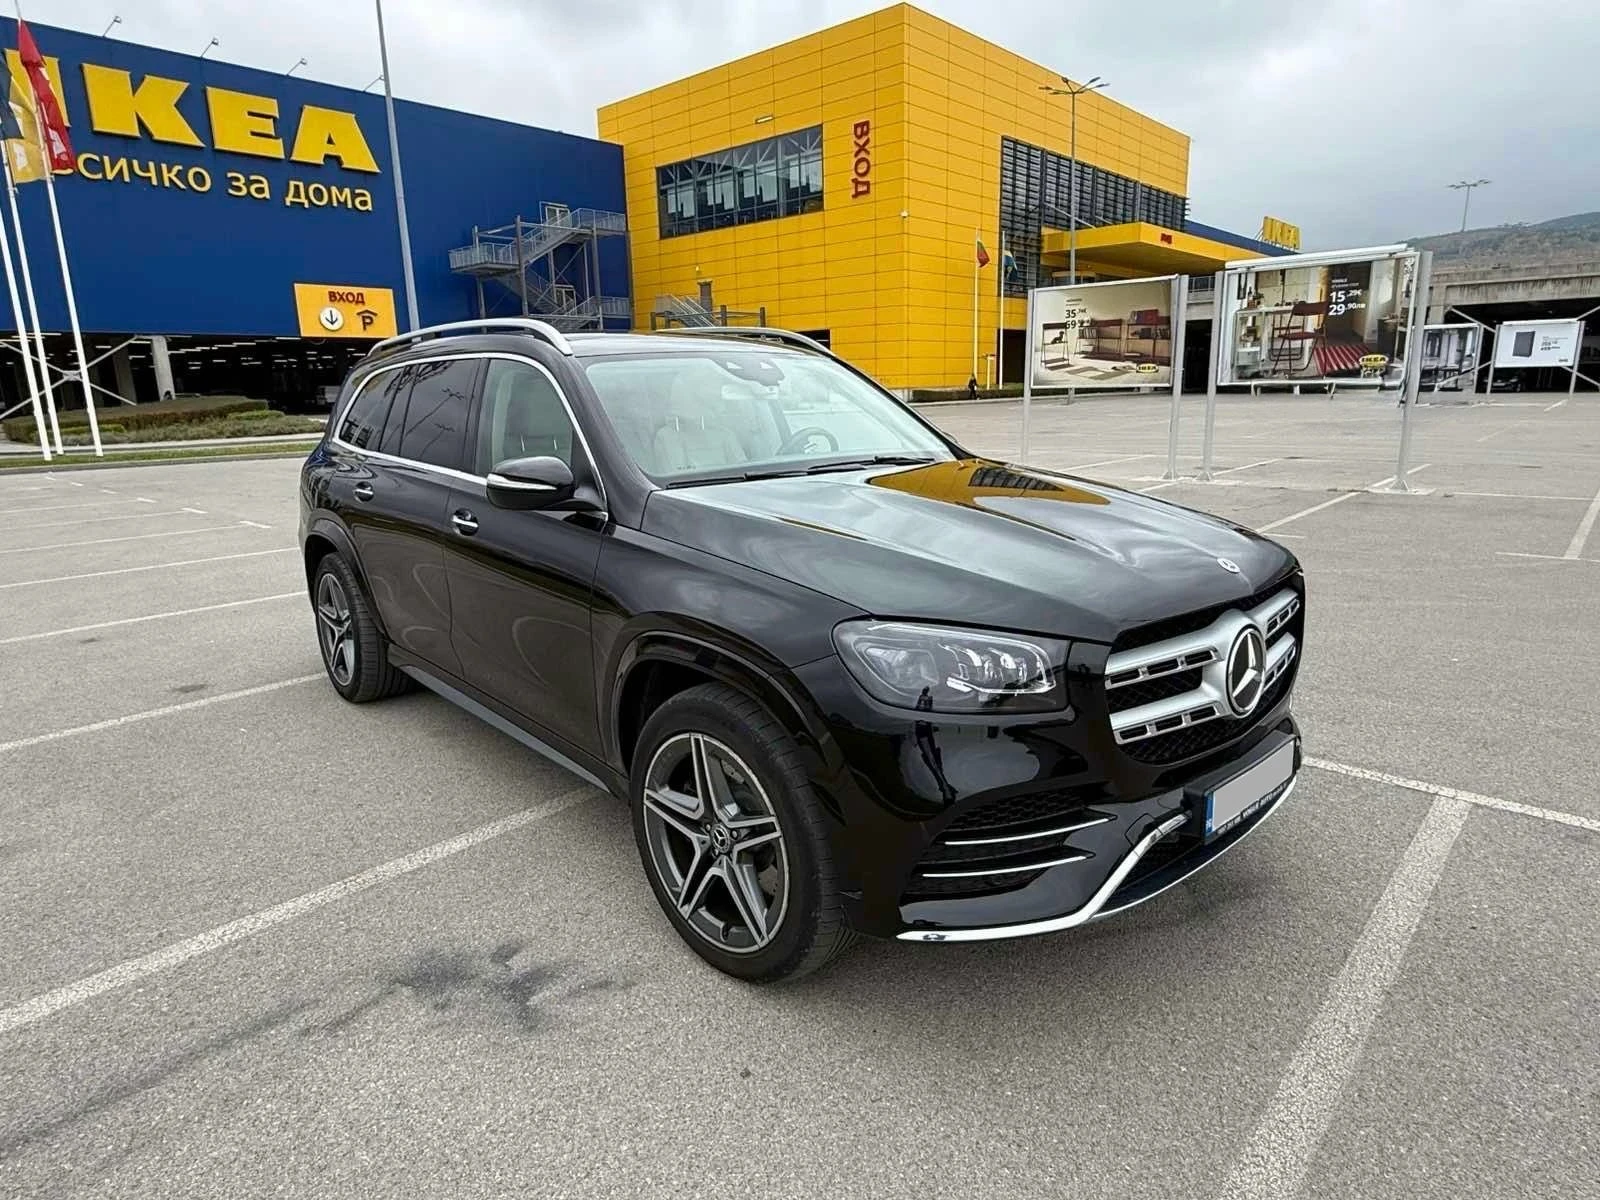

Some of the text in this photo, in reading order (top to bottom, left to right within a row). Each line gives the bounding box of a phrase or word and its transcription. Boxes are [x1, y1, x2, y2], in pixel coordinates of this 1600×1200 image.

[4, 48, 381, 173] IKEA
[51, 151, 373, 212] сичко за дома
[852, 120, 870, 199] ВХОД
[1263, 216, 1299, 250] IKEA
[328, 290, 366, 306] ВХОД
